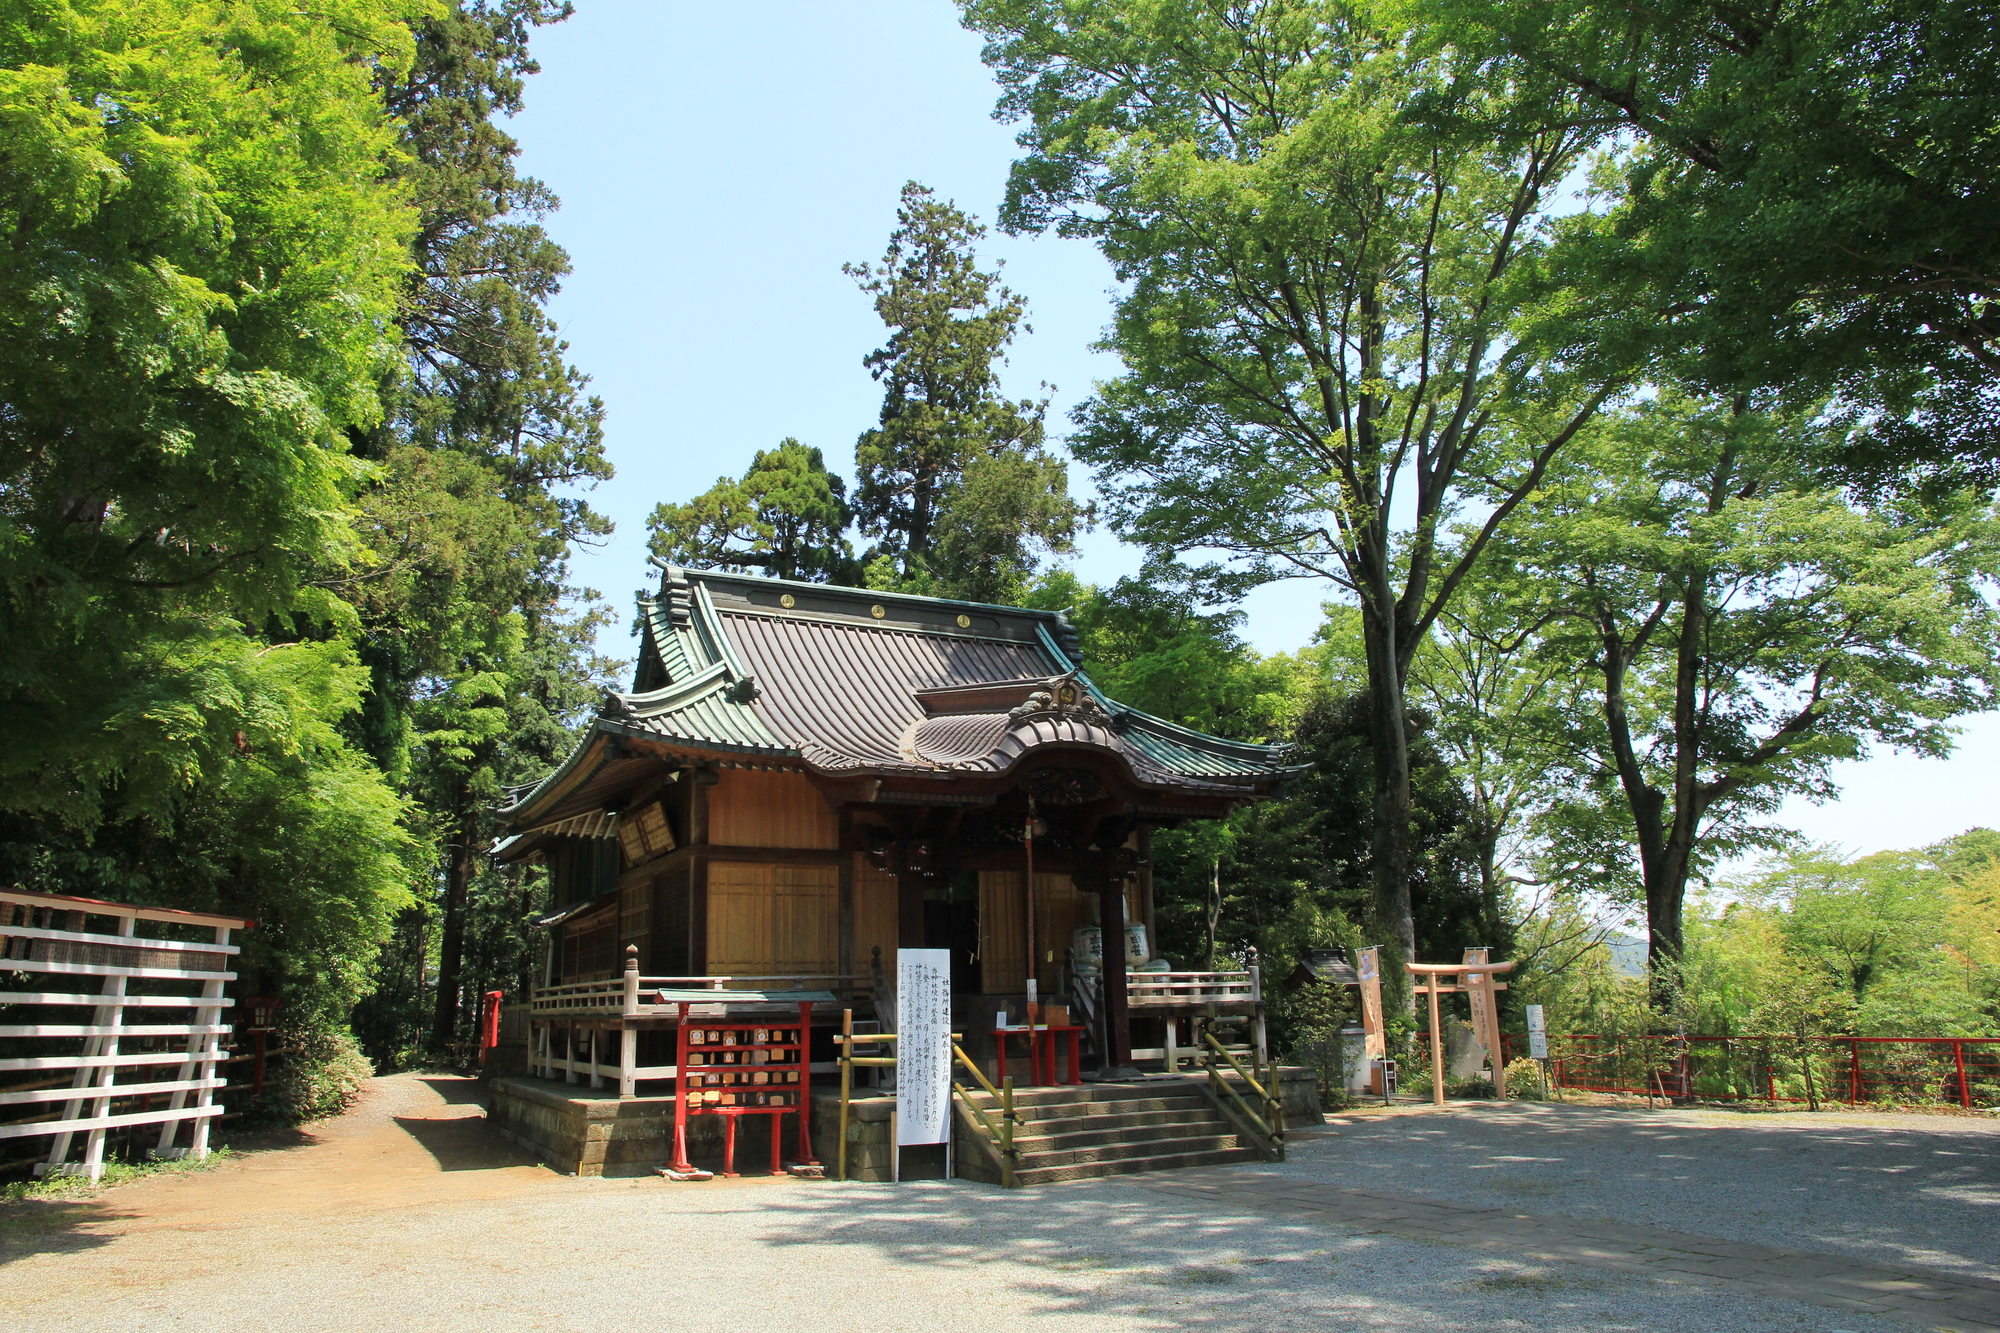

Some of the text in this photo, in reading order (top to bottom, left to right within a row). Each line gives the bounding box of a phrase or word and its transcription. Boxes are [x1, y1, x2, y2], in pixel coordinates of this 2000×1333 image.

[1129, 935, 1142, 957] 白笹
[942, 977, 950, 1025] 社務所建設
